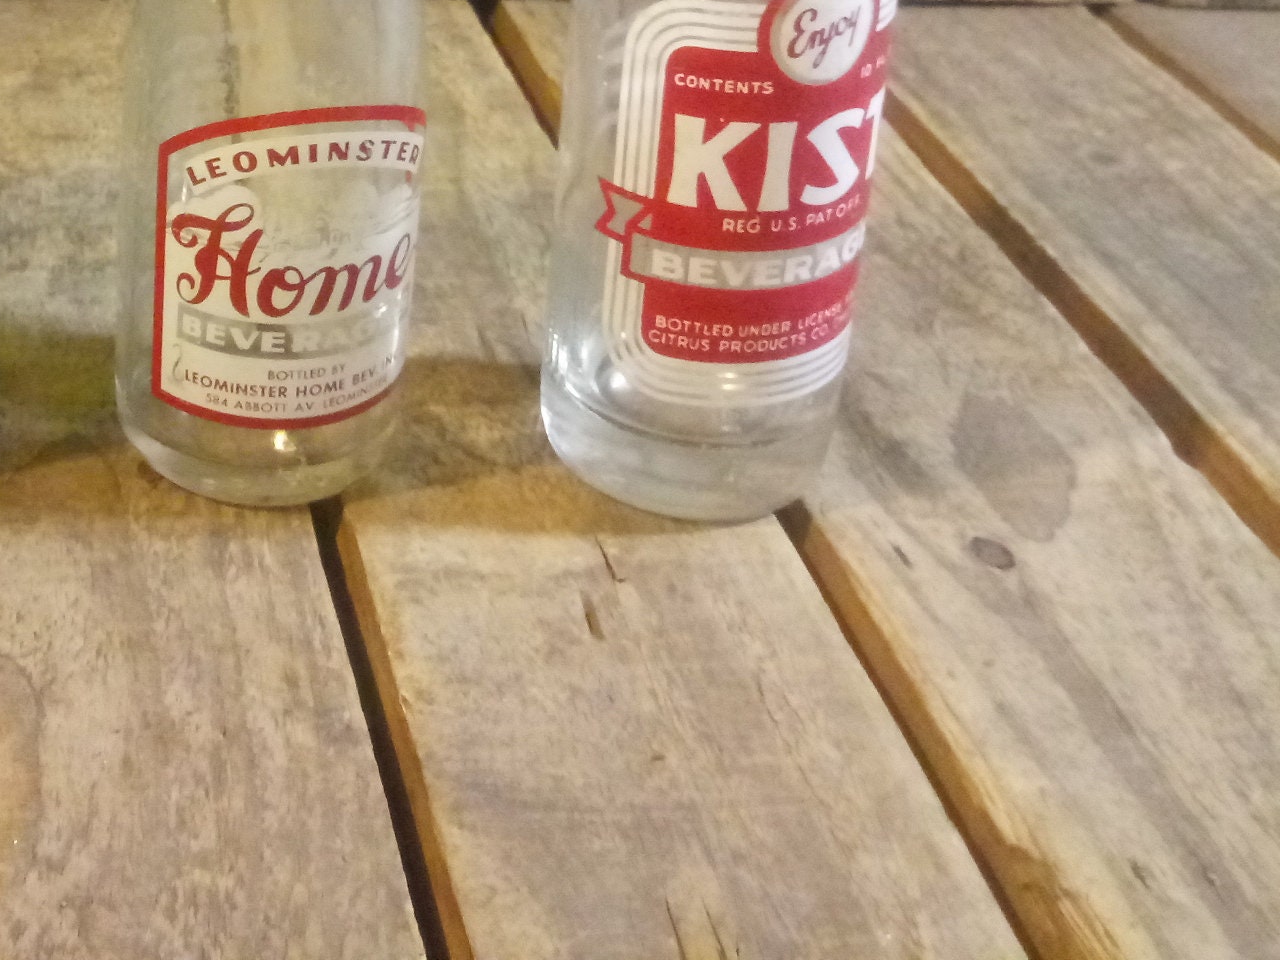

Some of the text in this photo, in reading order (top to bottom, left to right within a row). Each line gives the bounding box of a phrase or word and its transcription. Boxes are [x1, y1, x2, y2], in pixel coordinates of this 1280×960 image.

[786, 6, 862, 69] Enjoy
[674, 73, 775, 95] CONTENTS
[186, 139, 419, 187] LEOMINSTER
[722, 217, 761, 234] REG
[170, 202, 412, 318] Home
[656, 315, 733, 337] BOTTLED
[738, 320, 791, 337] UNDER
[648, 330, 710, 352] CITRUS
[719, 332, 806, 353] PRODUCTS
[185, 369, 288, 398] LEOMINSTER
[296, 379, 344, 398] HOME
[267, 363, 346, 381] BOTTLED BY
